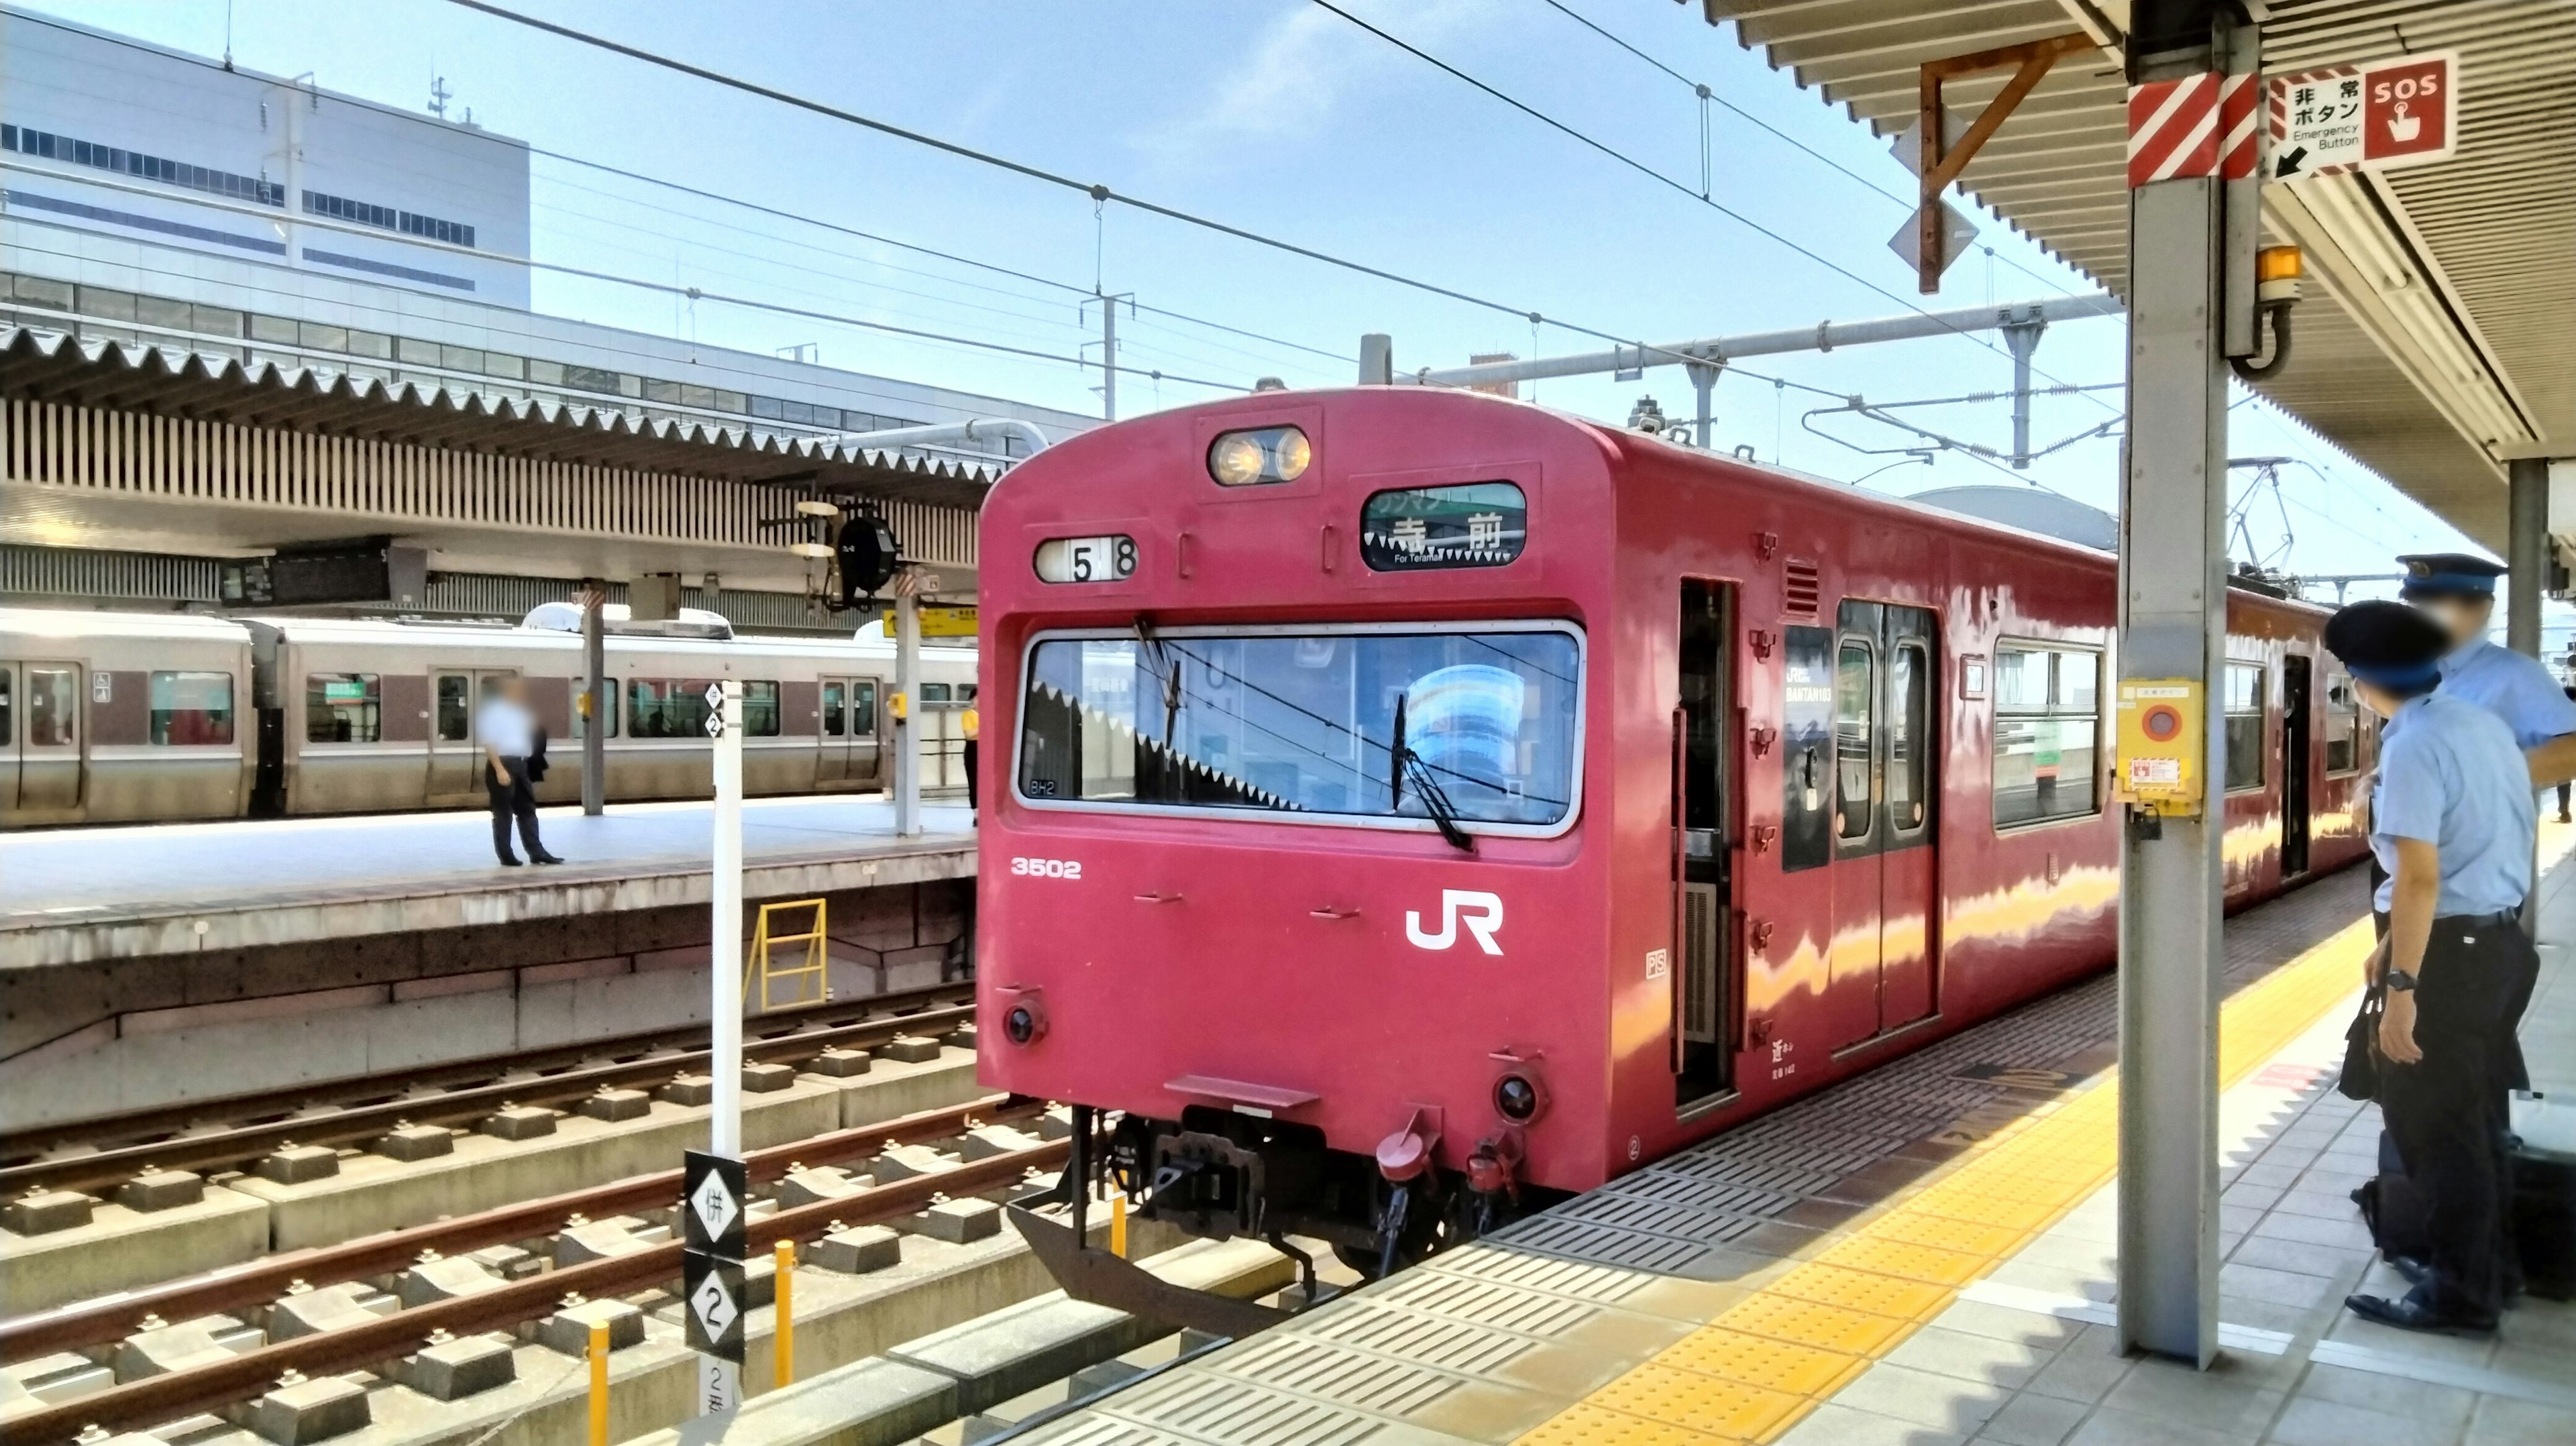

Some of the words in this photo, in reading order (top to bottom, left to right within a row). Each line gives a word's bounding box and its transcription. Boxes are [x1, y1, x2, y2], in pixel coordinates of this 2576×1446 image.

[2294, 80, 2359, 106] 非常
[2374, 74, 2438, 104] SOS
[2294, 103, 2359, 125] ボタン
[2294, 124, 2359, 142] Emergency
[2318, 137, 2359, 150] Button
[1393, 512, 1503, 553] 寺前
[1394, 554, 1407, 563] For
[1786, 687, 1831, 702] BANTAN103
[710, 718, 717, 732] 2
[1010, 856, 1082, 880] 3502
[1406, 889, 1504, 956] JR
[706, 1286, 722, 1328] 2
